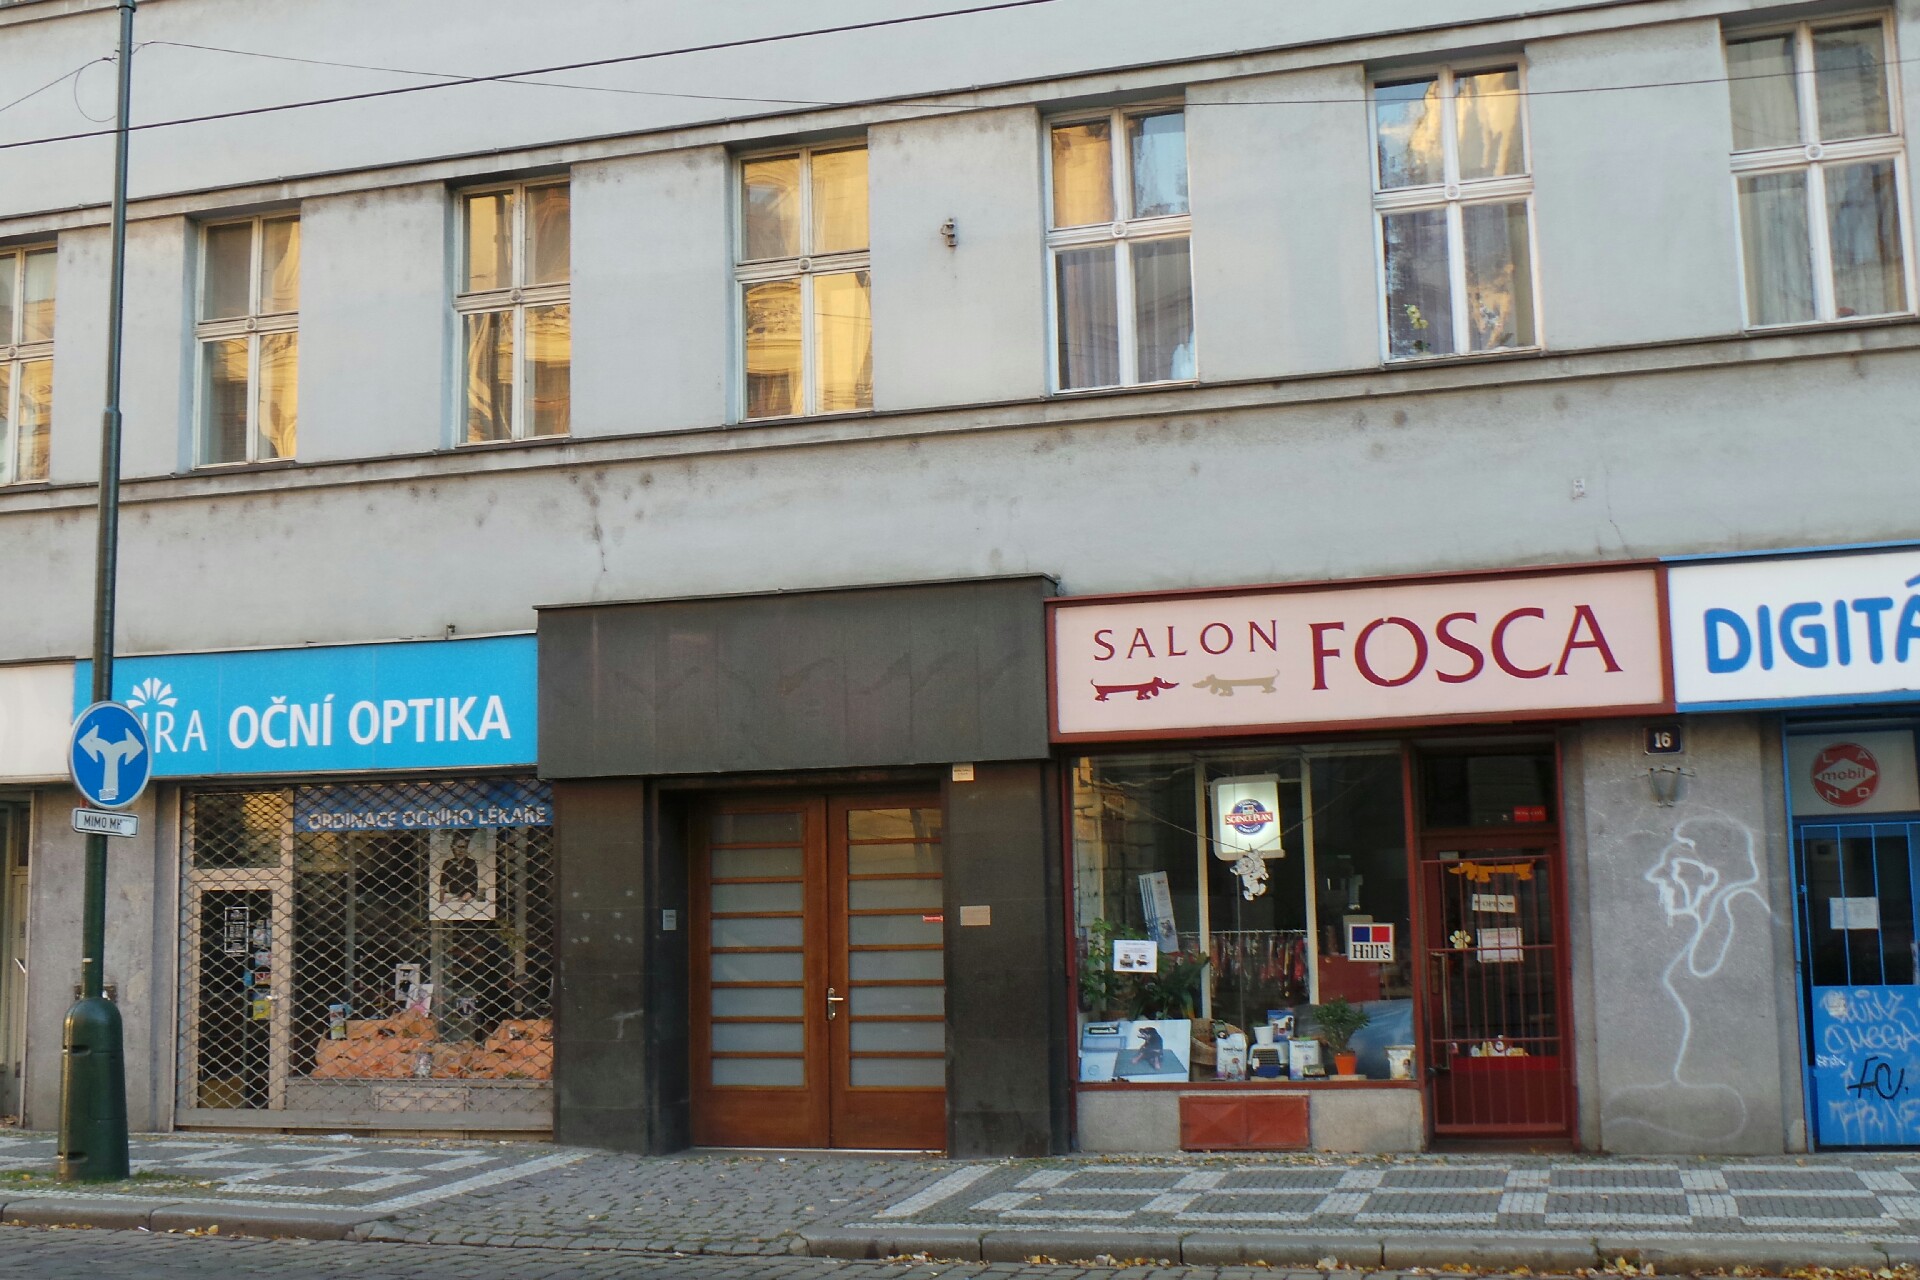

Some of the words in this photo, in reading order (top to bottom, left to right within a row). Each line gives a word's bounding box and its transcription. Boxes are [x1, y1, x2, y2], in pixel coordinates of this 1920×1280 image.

[1093, 619, 1279, 662] SALON
[1308, 604, 1624, 691] FOSCA
[228, 693, 336, 750] OČNÍ
[348, 694, 512, 746] OPTIKA
[1654, 732, 1671, 749] 16
[1822, 767, 1866, 781] mobil
[83, 814, 107, 829] MIMO
[308, 811, 397, 830] ORDINACE
[478, 804, 546, 825] LÉKAŘE
[1353, 944, 1391, 960] Hill's
